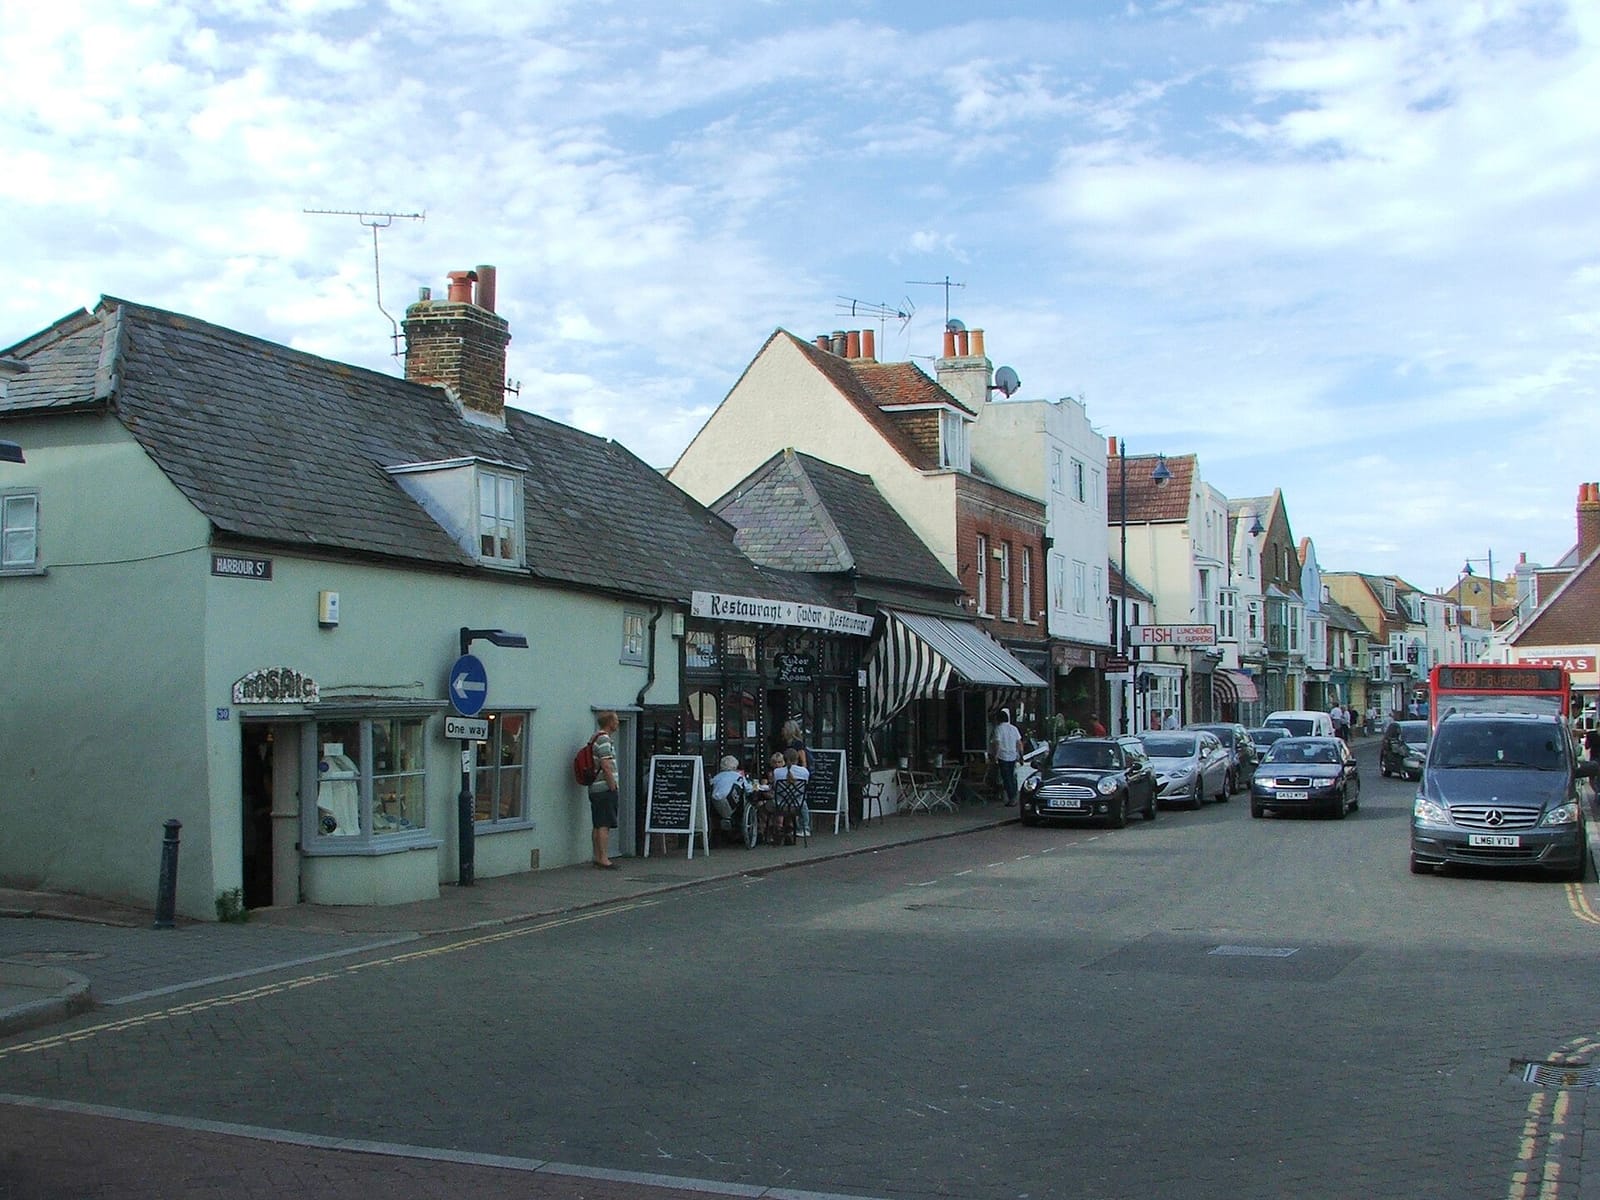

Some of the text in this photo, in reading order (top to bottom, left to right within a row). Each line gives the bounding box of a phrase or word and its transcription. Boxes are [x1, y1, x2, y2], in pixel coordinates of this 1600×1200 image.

[216, 558, 254, 575] HARBOUR
[711, 594, 869, 632] Restaurant Tudor Restaurant
[1142, 628, 1173, 643] FISH
[1176, 627, 1213, 635] LUNCHEONS
[1185, 635, 1213, 643] SUPPERS
[447, 722, 486, 737] One way
[1474, 836, 1495, 845] LM61
